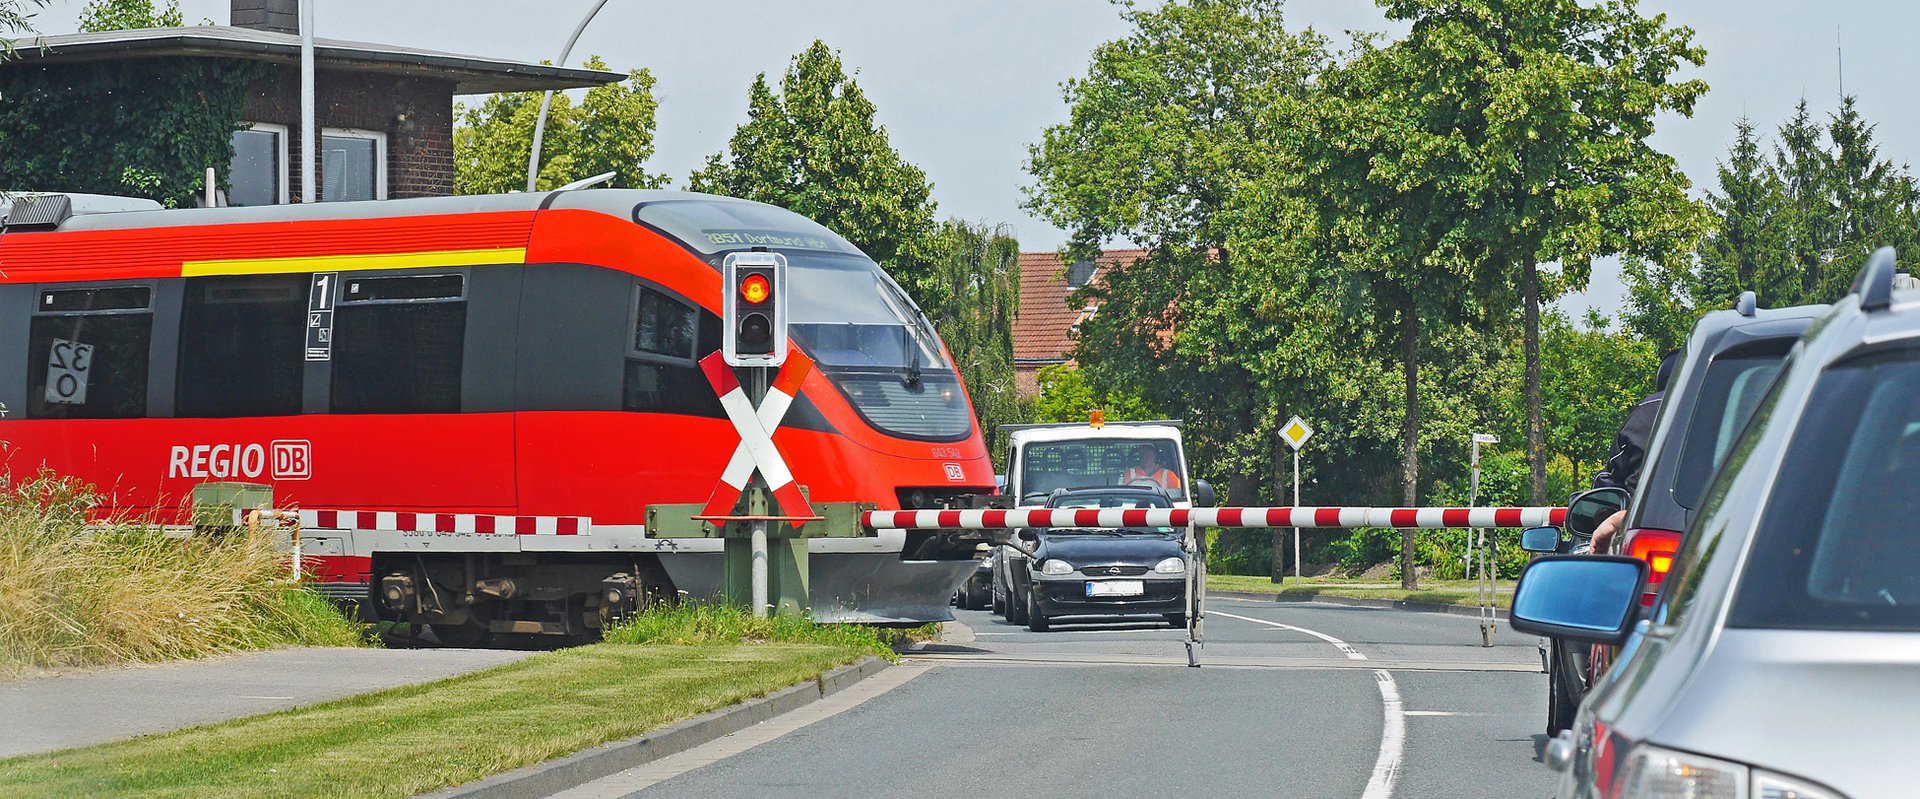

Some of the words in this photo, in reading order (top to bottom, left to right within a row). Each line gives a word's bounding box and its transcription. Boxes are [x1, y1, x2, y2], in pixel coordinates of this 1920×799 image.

[316, 275, 329, 309] 1
[169, 443, 265, 478] REGIO
[275, 445, 307, 475] DB
[945, 465, 963, 479] DB
